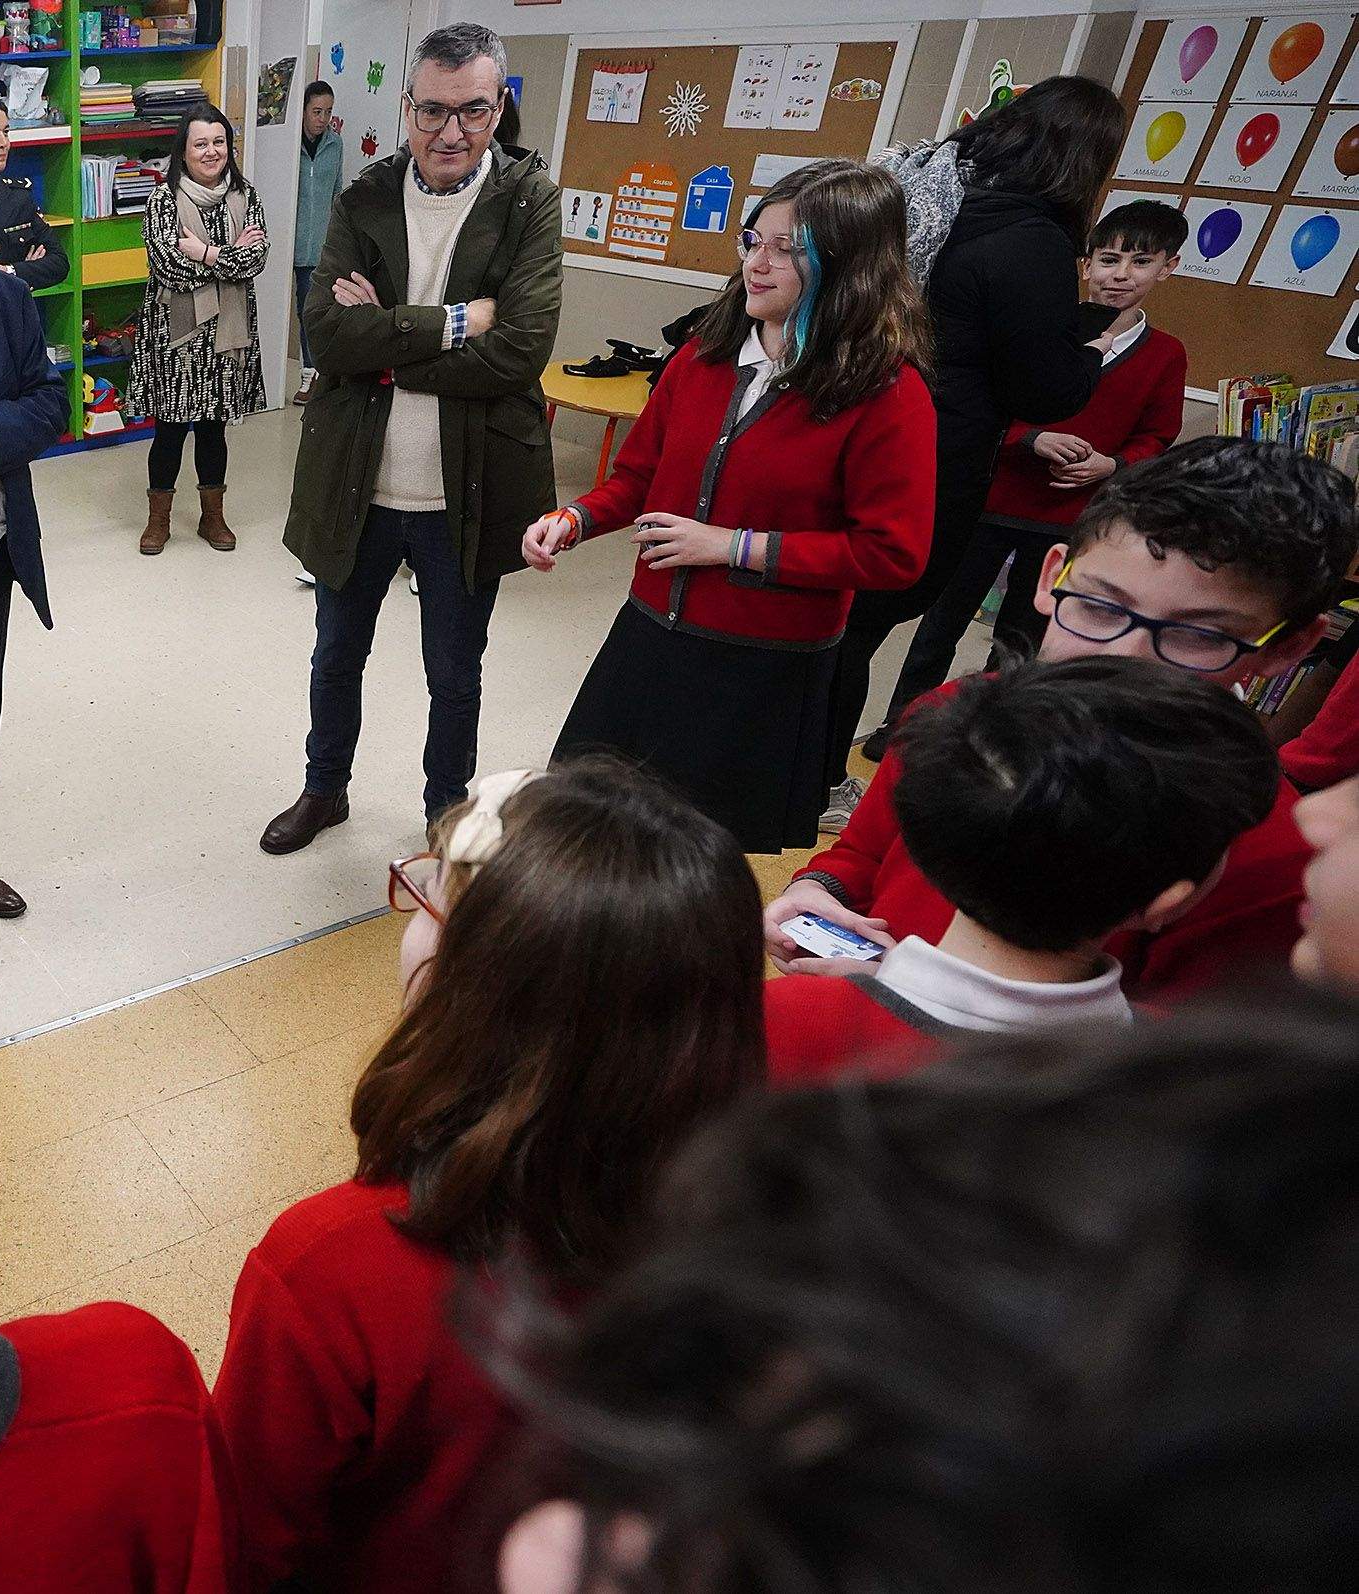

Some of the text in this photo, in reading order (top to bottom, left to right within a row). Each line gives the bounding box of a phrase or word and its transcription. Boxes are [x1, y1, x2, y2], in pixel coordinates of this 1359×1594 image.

[1170, 88, 1194, 96] ROSA
[1255, 89, 1299, 98] NARANJA
[1132, 168, 1170, 177] AMARILLO
[1227, 174, 1252, 184] ROJO
[1182, 264, 1220, 276] MORADO
[1283, 276, 1307, 287] AZUL
